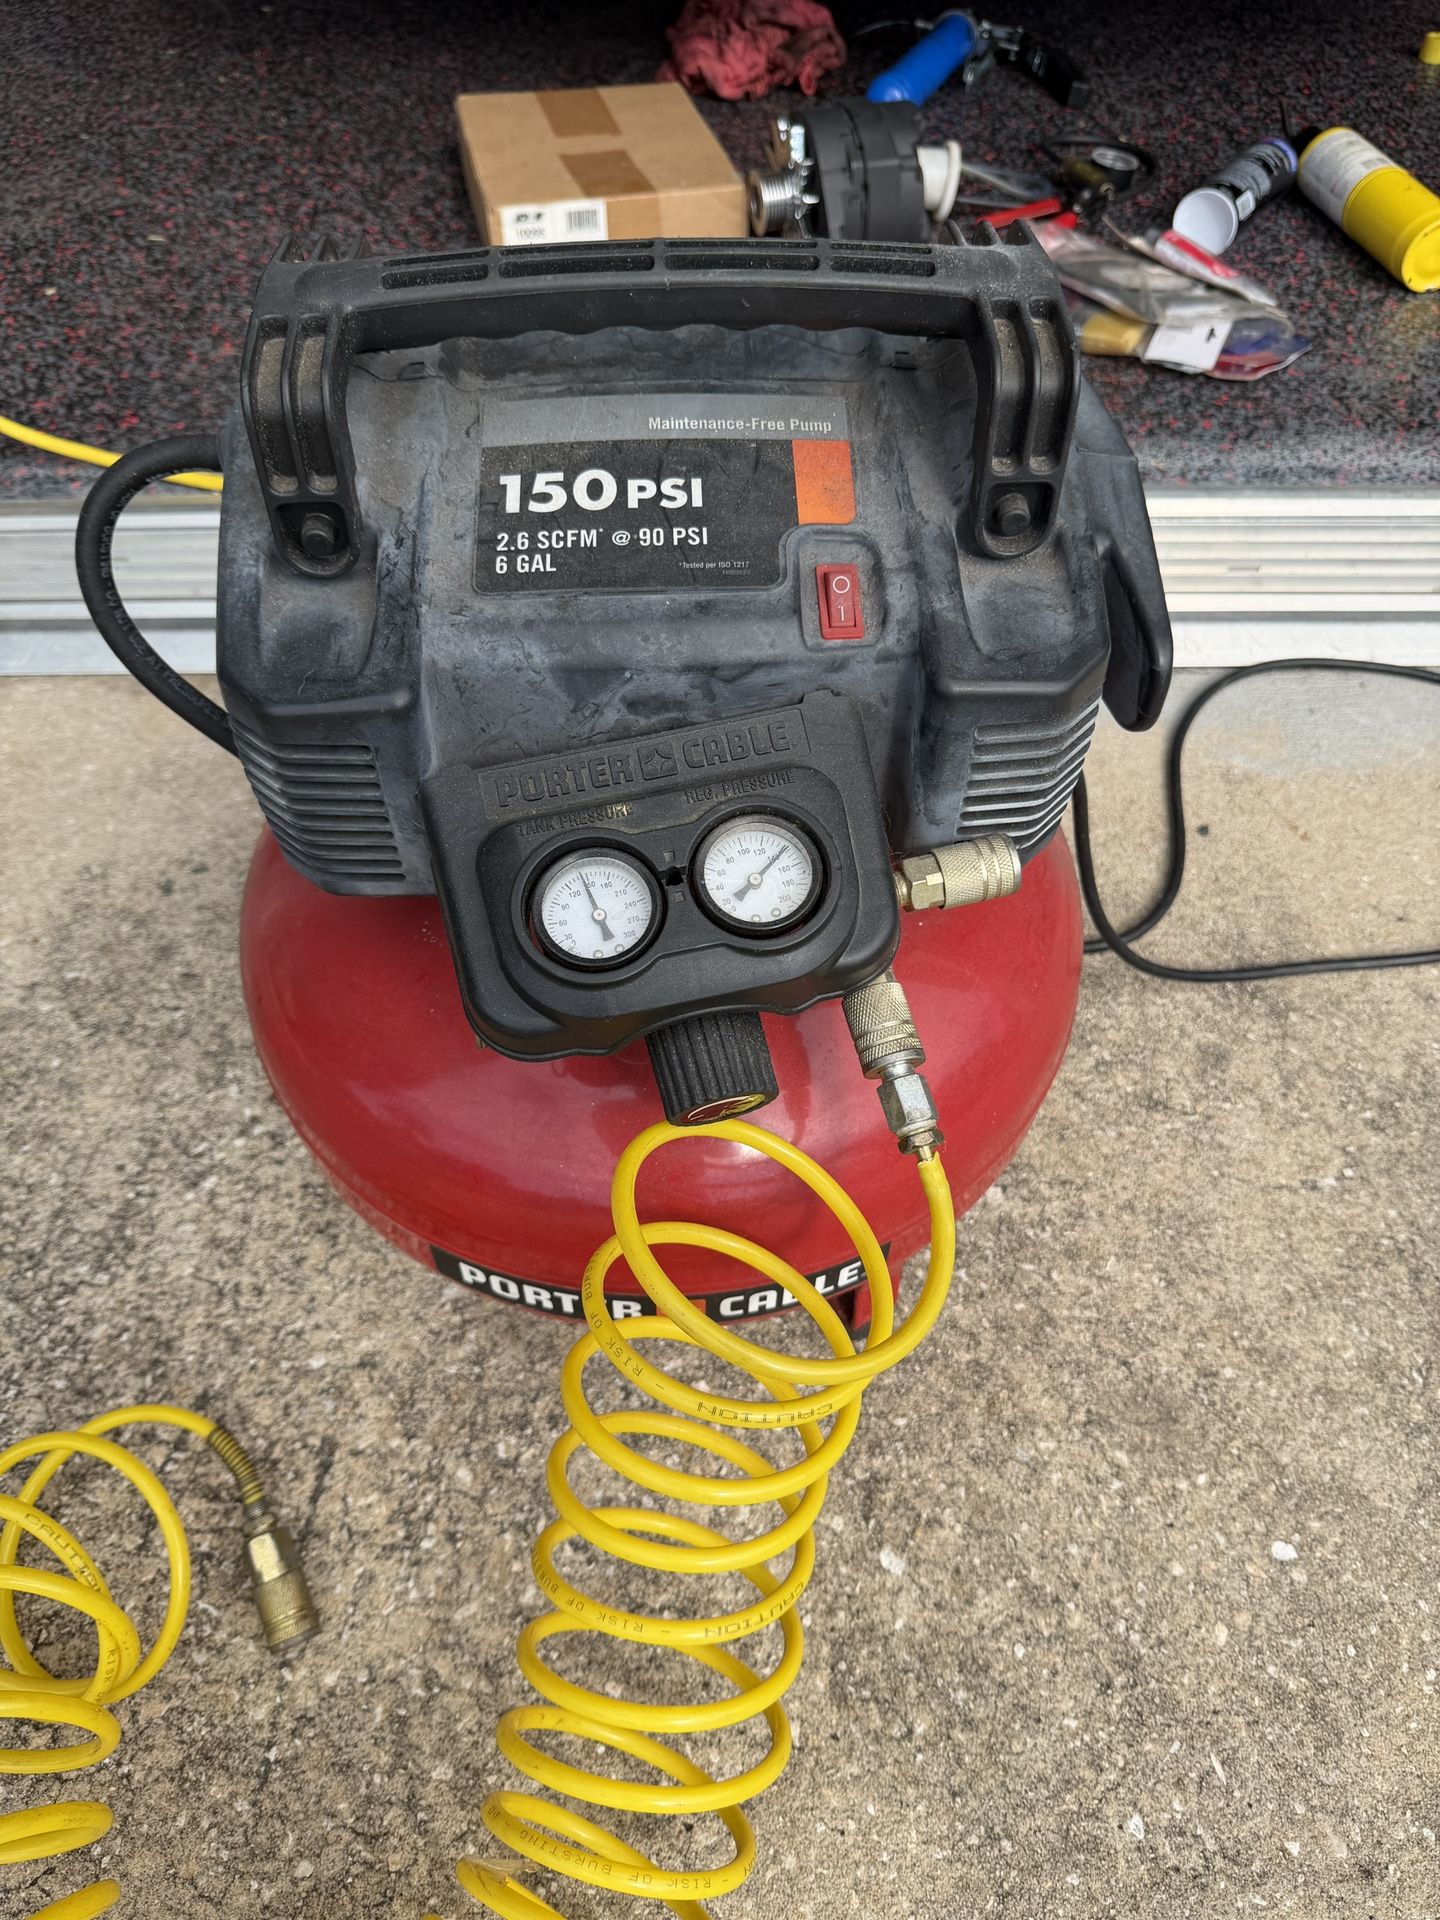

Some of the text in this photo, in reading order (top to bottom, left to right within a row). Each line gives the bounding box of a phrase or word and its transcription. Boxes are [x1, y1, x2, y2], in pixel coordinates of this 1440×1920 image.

[648, 417, 832, 434] Maintenance-Free Pump
[500, 469, 703, 514] 150 PSI
[496, 531, 530, 551] 2.6
[611, 530, 631, 546] @
[639, 527, 665, 547] 90
[672, 526, 708, 546] PSI
[495, 553, 557, 574] 6 GAL
[705, 562, 717, 570] per
[733, 560, 750, 568] 1217
[494, 721, 792, 808] PORTER CABLE
[722, 770, 796, 796] PRESSURE
[516, 802, 634, 837] TANK PRESSURE
[737, 847, 750, 857] 100
[753, 847, 766, 857] 120
[725, 856, 735, 865] 80
[717, 869, 726, 877] 60
[778, 865, 791, 875] 160
[600, 881, 613, 890] 180
[782, 878, 795, 888] 180
[569, 889, 582, 899] 120
[615, 888, 628, 898] 210
[561, 903, 570, 911] 90
[624, 901, 637, 910] 240
[559, 919, 568, 927] 60
[624, 930, 636, 939] 300
[458, 1261, 643, 1320] PORTR
[589, 1311, 604, 1329] OF
[606, 1336, 644, 1377] RISK
[697, 1401, 833, 1425] CAUTION
[566, 1597, 585, 1613] OF
[705, 1582, 805, 1639] CAUTION
[597, 1610, 644, 1633] RISK
[520, 1828, 613, 1876] BURSTING
[628, 1871, 652, 1884] OF
[666, 1878, 711, 1889] RISK
